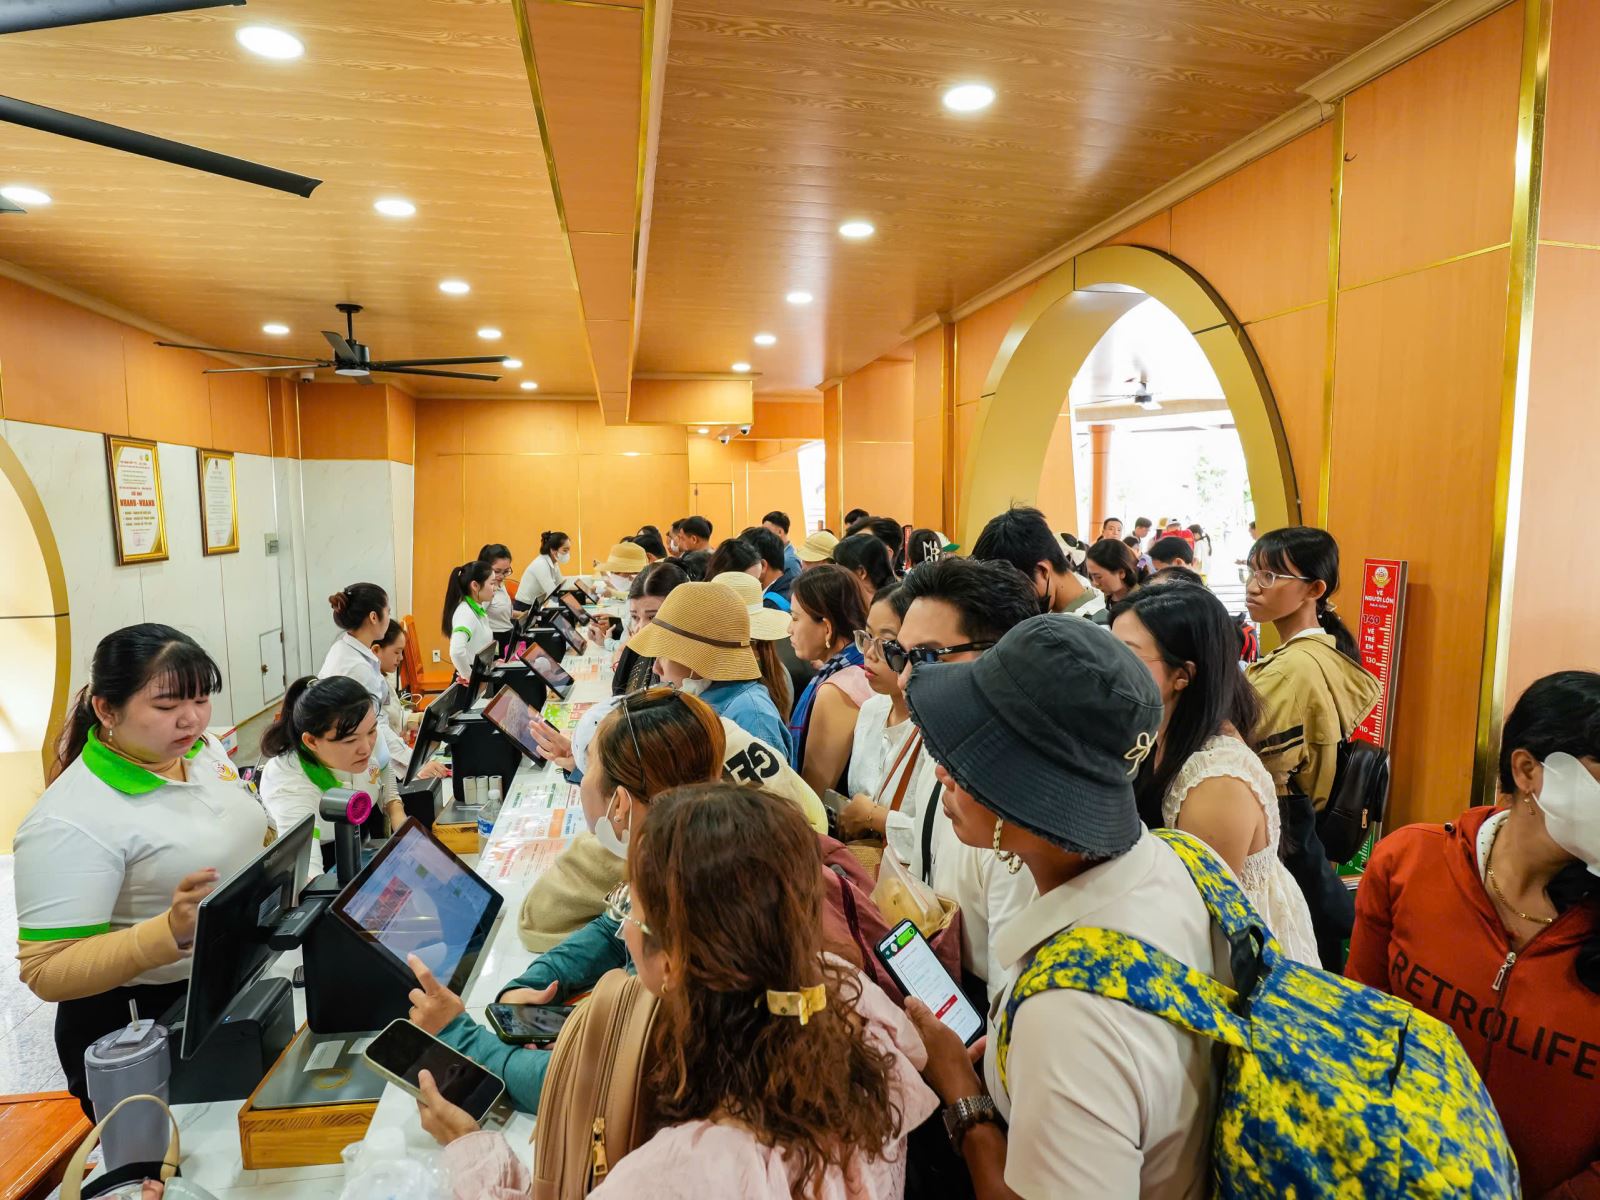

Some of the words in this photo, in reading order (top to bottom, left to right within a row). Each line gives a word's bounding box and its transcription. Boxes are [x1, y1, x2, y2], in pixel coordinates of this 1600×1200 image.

[1362, 614, 1380, 625] 140
[1366, 656, 1376, 664] 130
[1359, 725, 1368, 733] 110
[1391, 951, 1600, 1080] RETROLIFE
